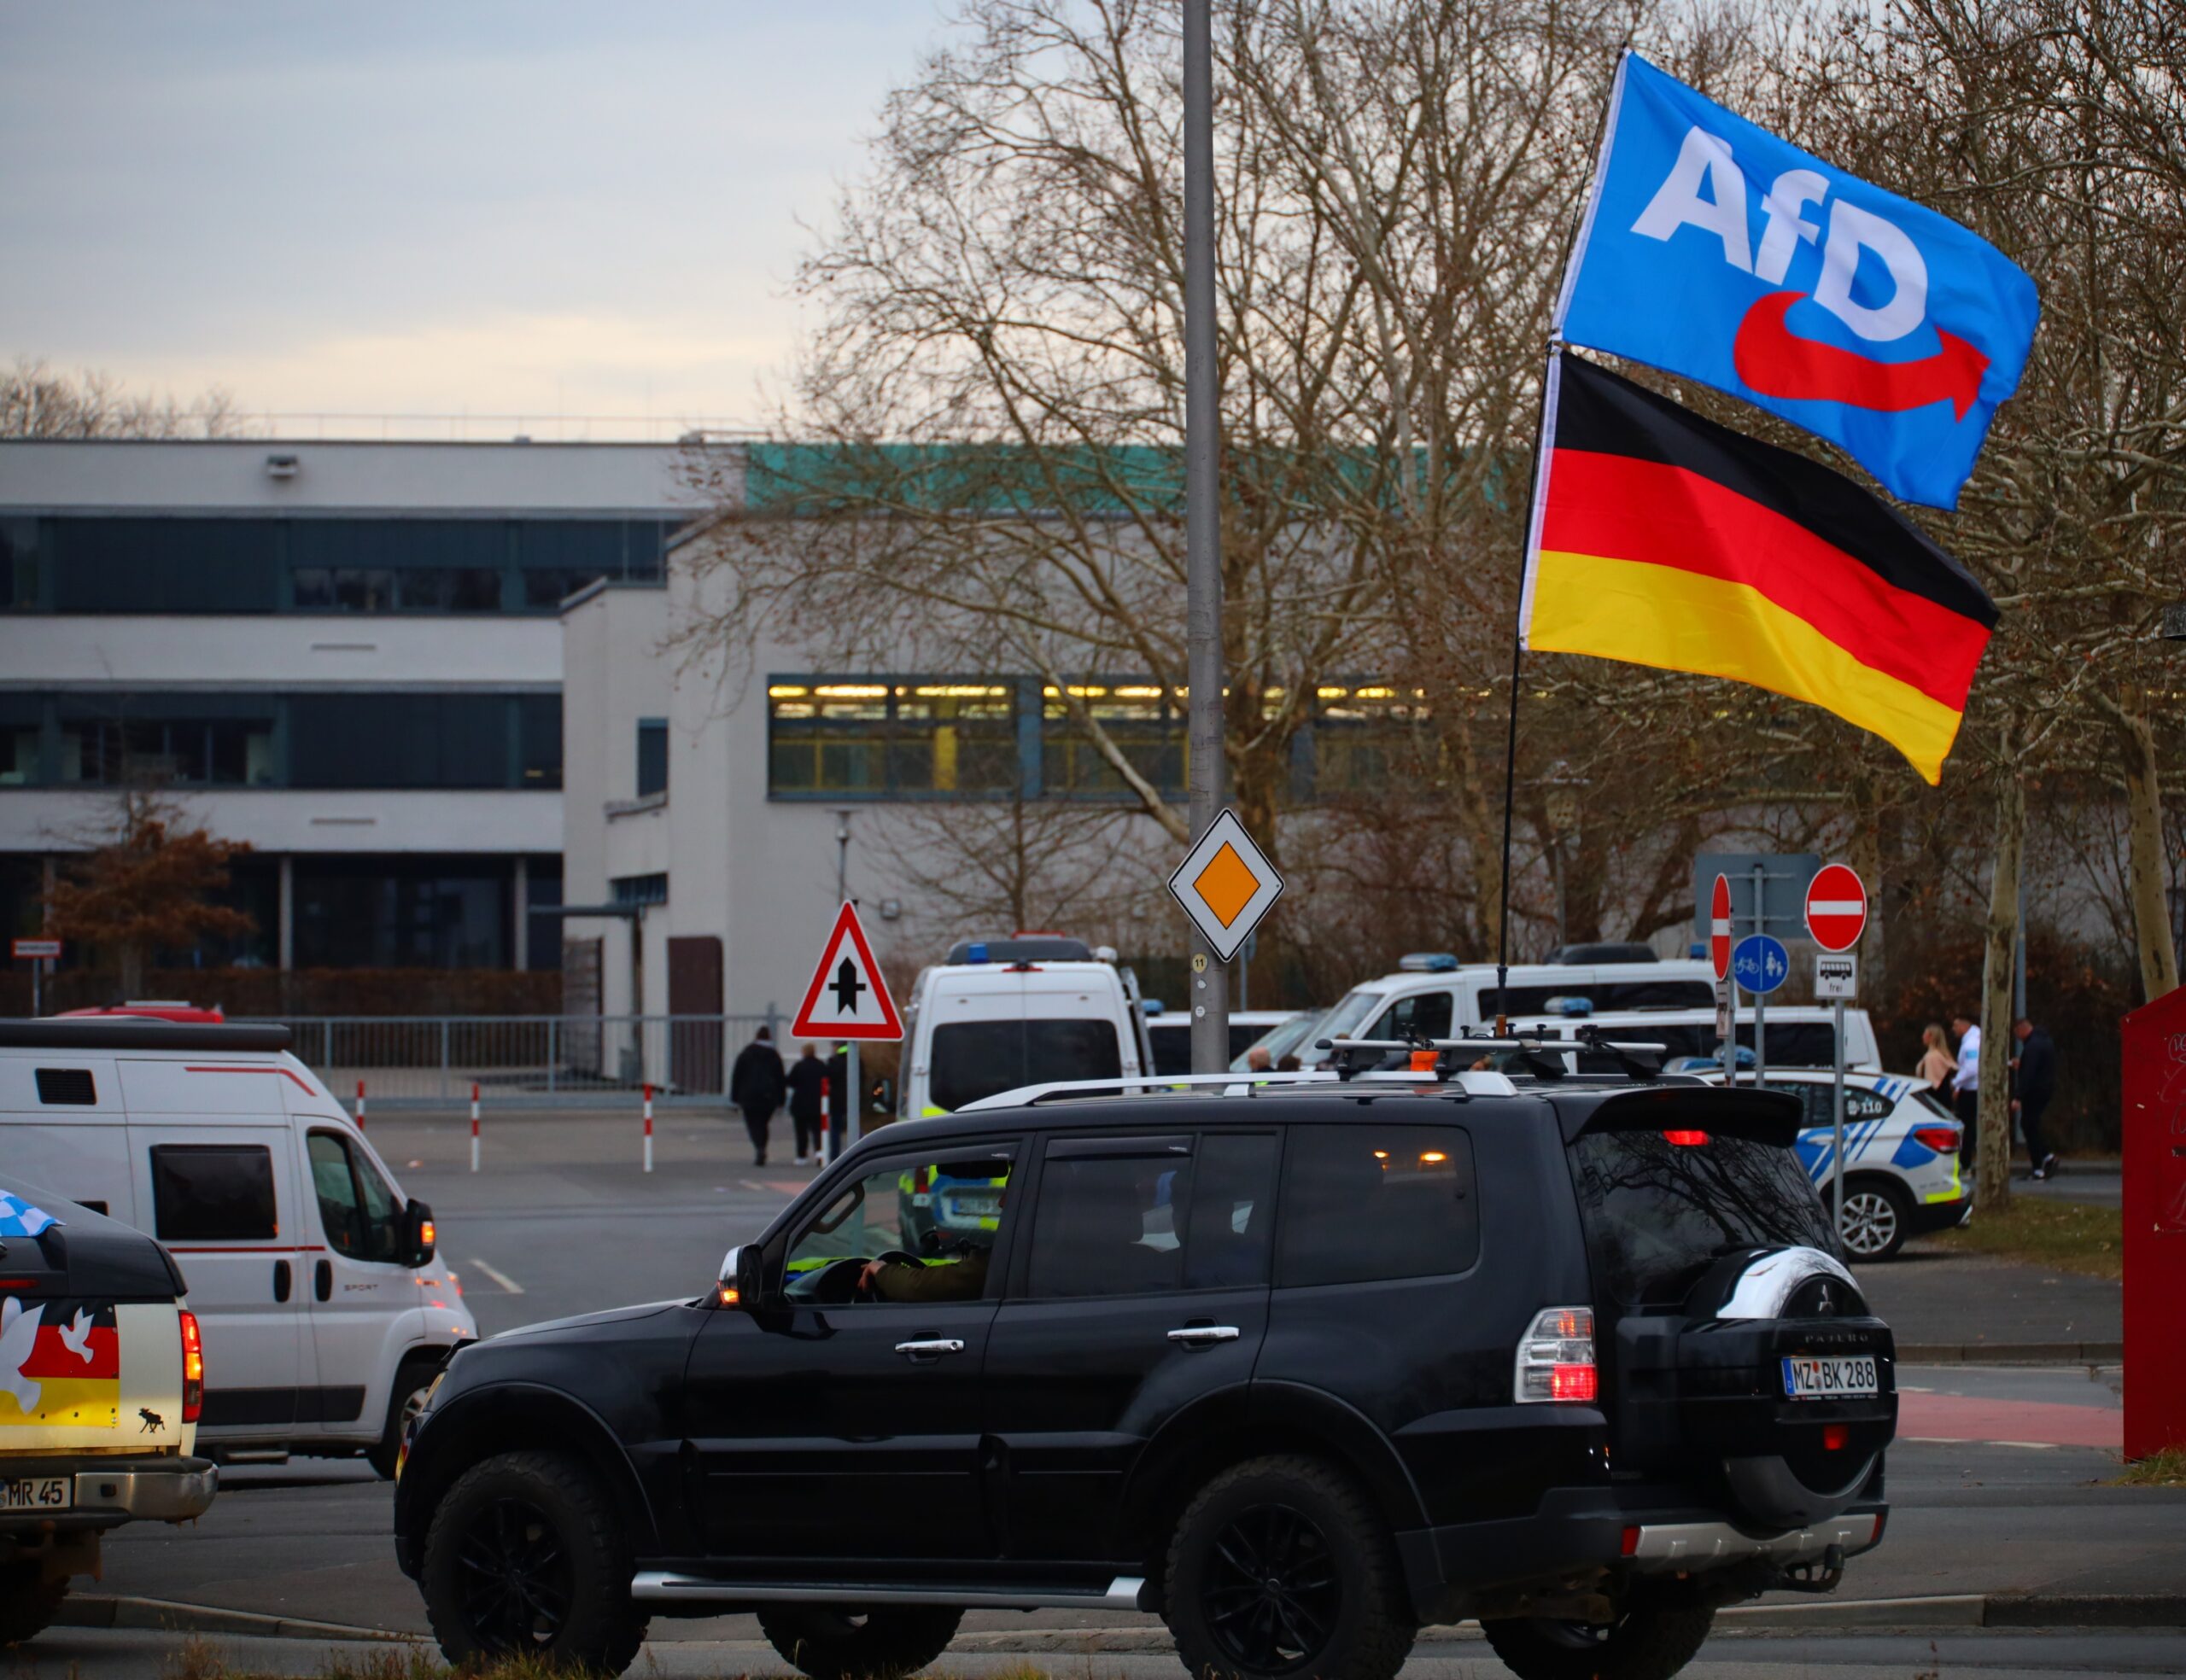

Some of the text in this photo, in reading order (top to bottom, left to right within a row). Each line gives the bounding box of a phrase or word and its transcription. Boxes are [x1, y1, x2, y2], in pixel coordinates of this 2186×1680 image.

[1630, 125, 1927, 341] AfD
[1195, 958, 1204, 967] 11
[1829, 983, 1843, 993] frei
[1862, 1100, 1883, 1113] 110
[1805, 1333, 1868, 1343] PAJERO
[1793, 1361, 1875, 1390] MZ BK 288
[9, 1480, 63, 1506] MR 45
